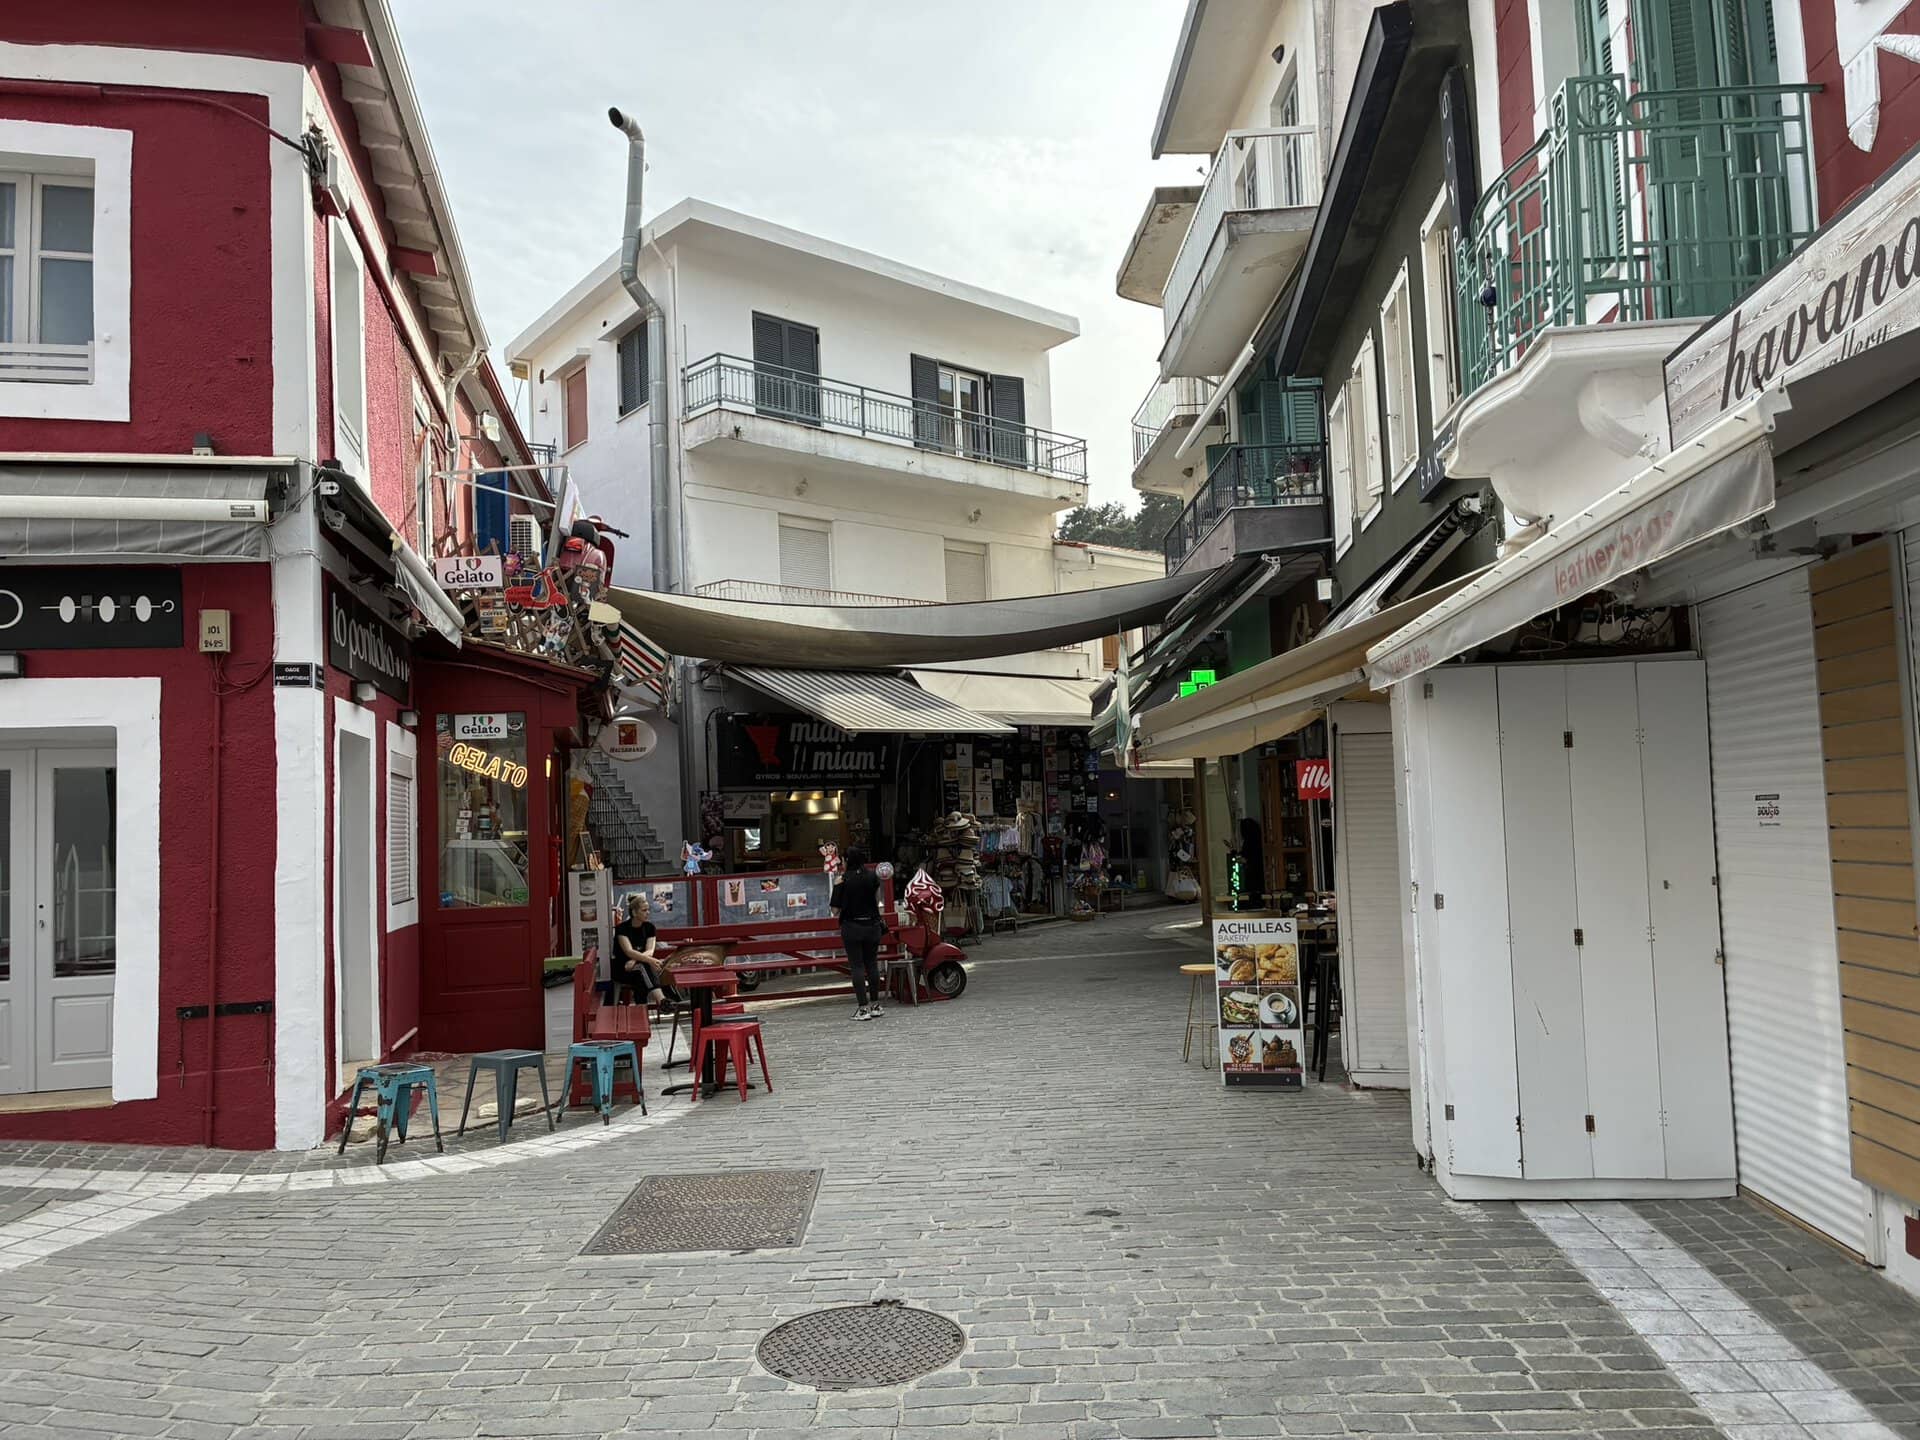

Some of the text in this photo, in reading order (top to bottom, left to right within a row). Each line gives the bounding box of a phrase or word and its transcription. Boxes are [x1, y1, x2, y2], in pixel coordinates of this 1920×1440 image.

[444, 570, 494, 584] Gelato
[208, 626, 221, 634] 101
[461, 725, 501, 735] Gelato
[449, 742, 528, 788] GELATO
[1300, 765, 1331, 794] illy
[1218, 922, 1292, 934] ACHILLEAS
[1218, 934, 1250, 943] BAKERY
